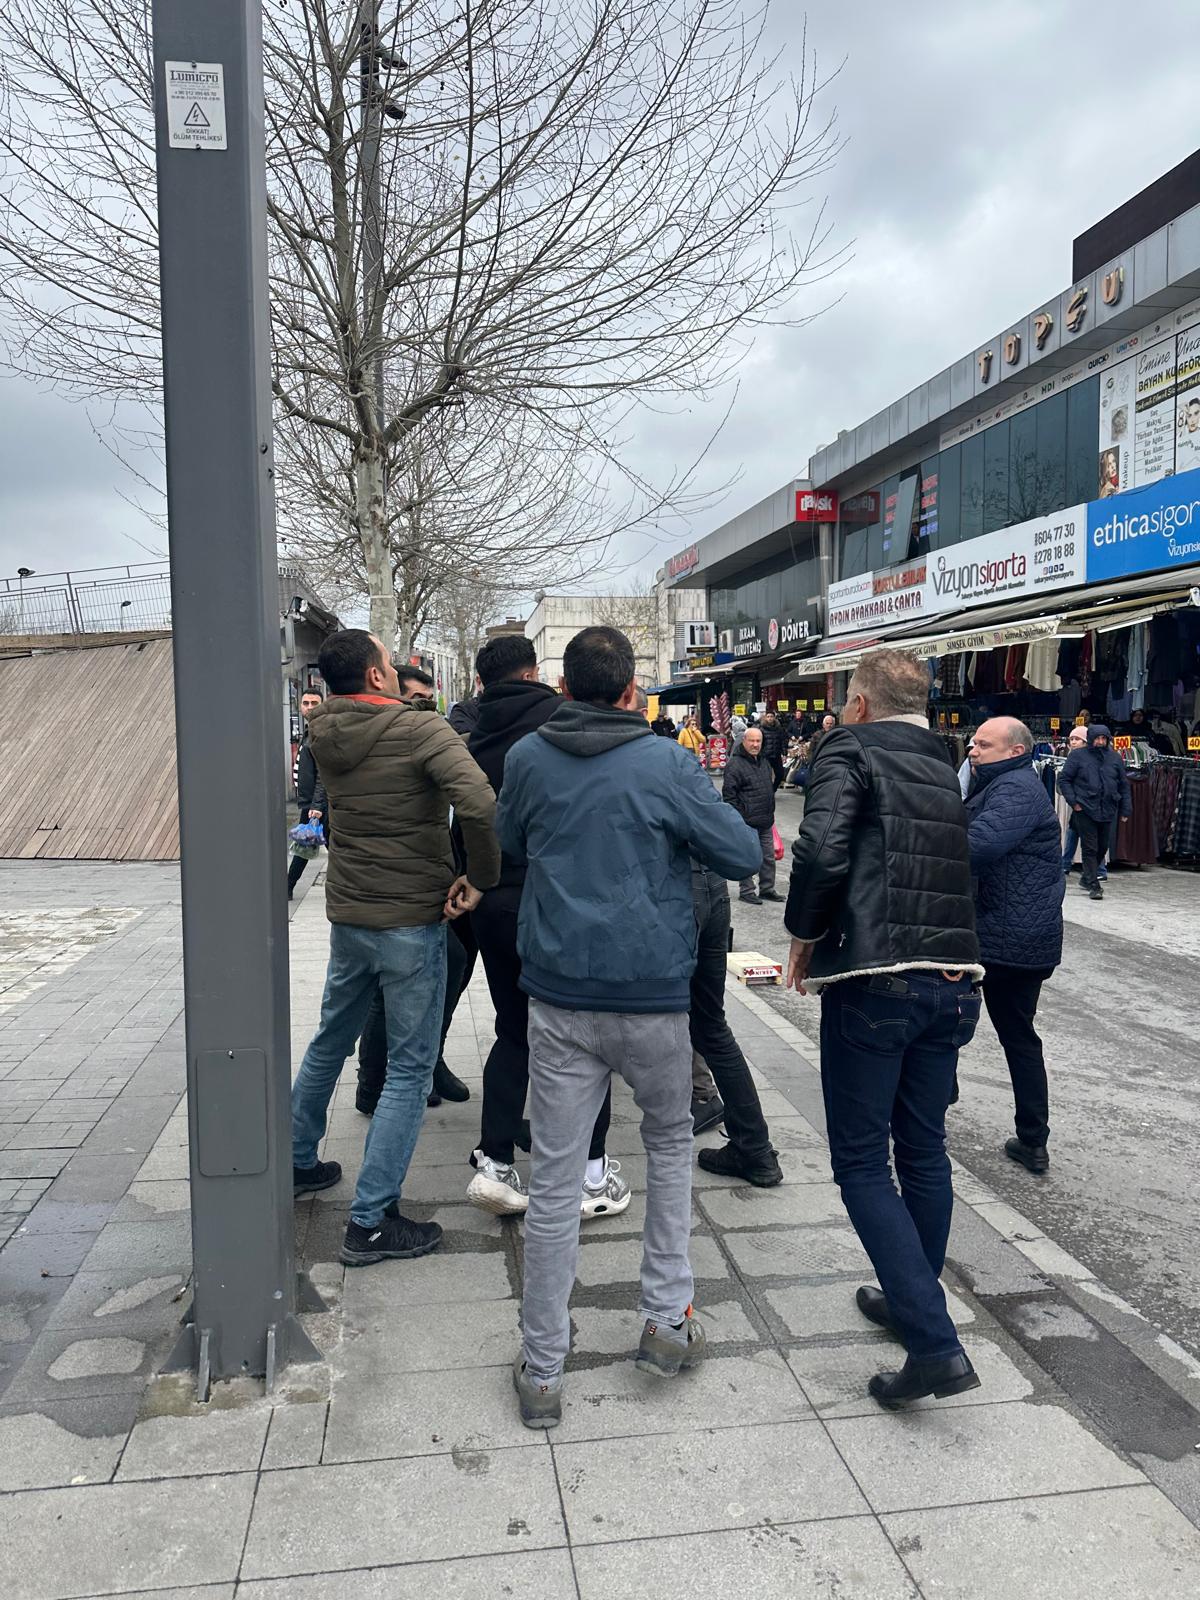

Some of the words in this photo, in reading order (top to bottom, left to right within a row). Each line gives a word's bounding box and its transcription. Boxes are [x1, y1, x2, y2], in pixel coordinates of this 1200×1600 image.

[1138, 351, 1171, 375] Emine
[1138, 372, 1164, 392] BAYAN
[1122, 451, 1130, 489] Makeup
[1054, 525, 1063, 541] 77
[1064, 522, 1075, 538] 30
[1053, 545, 1063, 560] 18
[1064, 542, 1075, 557] 88
[850, 598, 887, 621] AYAKKABI
[888, 597, 893, 612] &
[781, 619, 809, 642] DÖNER
[1115, 738, 1128, 748] 500
